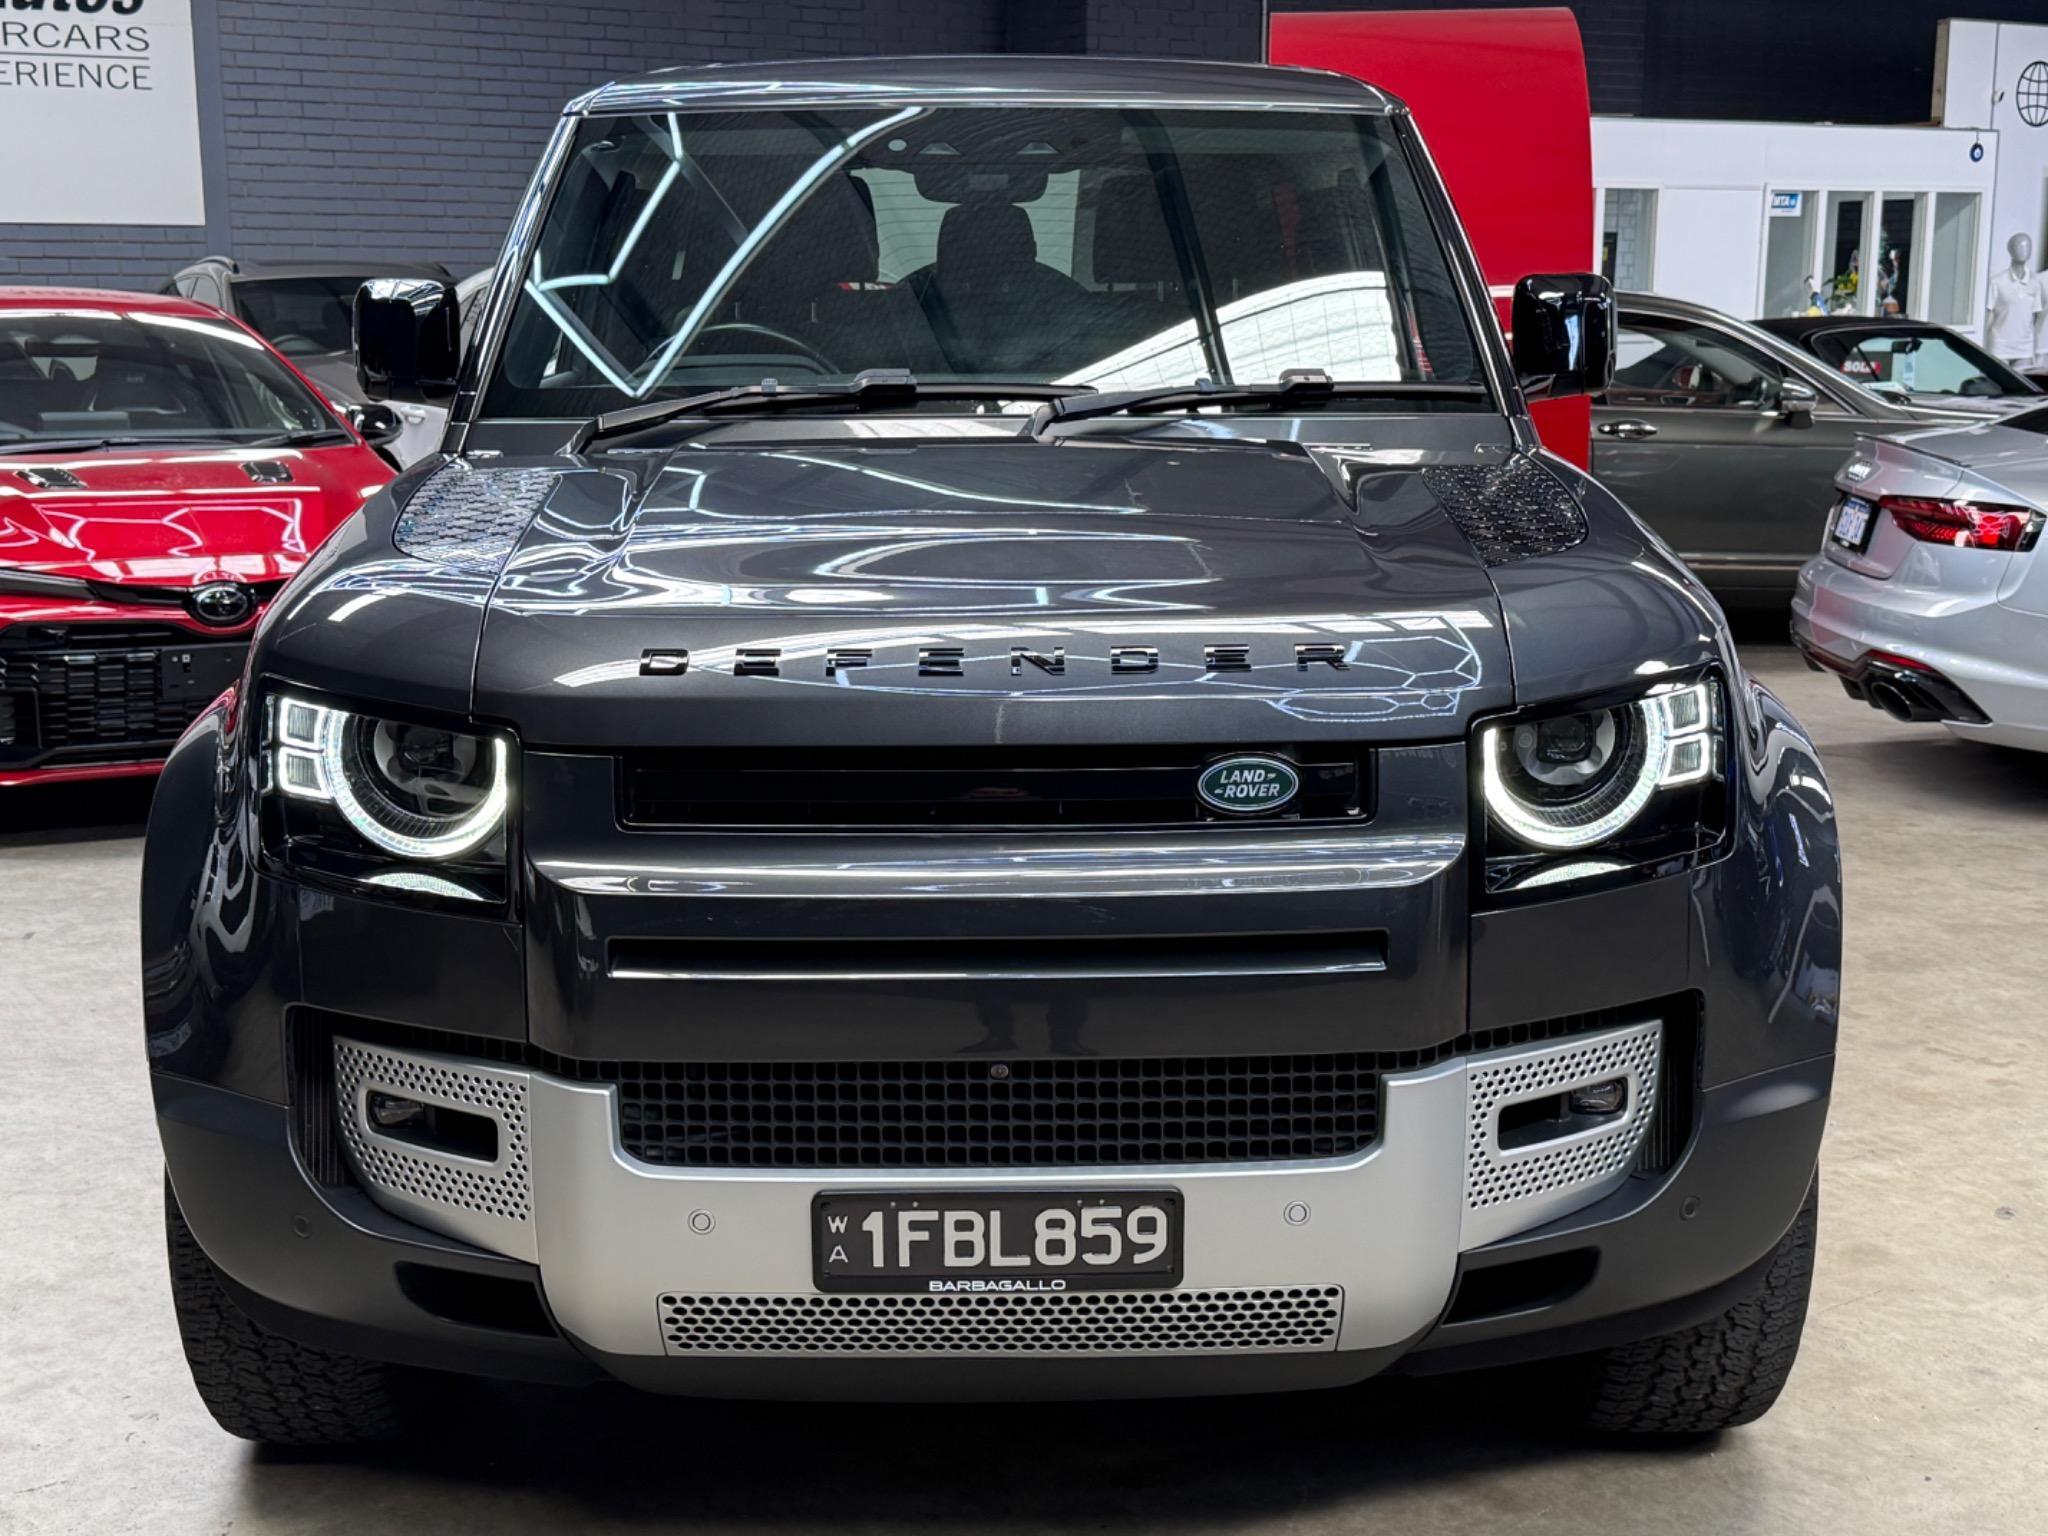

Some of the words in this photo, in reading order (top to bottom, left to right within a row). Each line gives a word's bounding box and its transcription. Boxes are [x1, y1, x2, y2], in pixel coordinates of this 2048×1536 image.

[639, 643, 1351, 677] DEFENDER
[1224, 783, 1281, 799] ROVER
[861, 1206, 1168, 1268] 1FBL859
[929, 1279, 1067, 1292] BARBAGALLO
